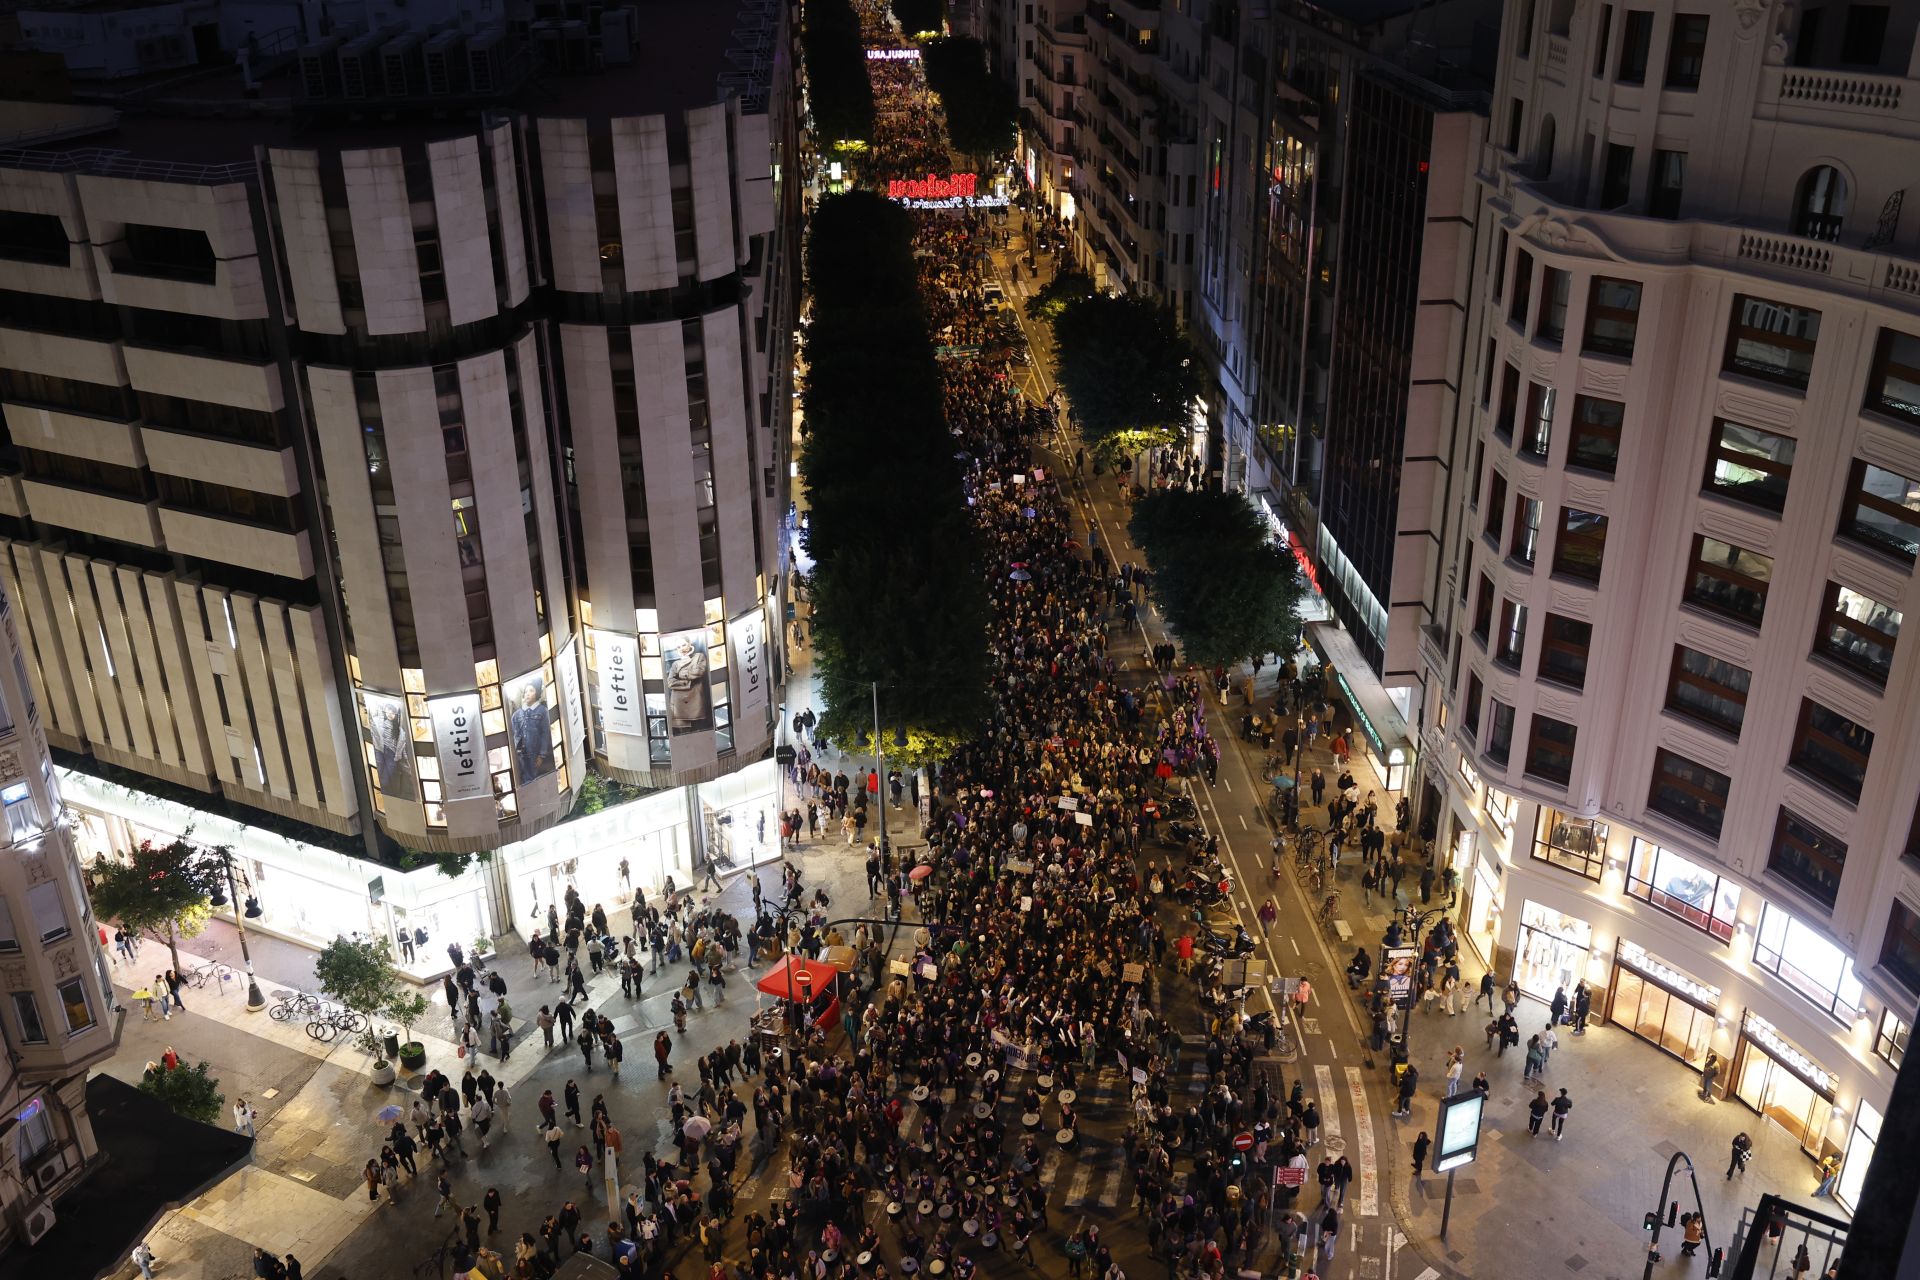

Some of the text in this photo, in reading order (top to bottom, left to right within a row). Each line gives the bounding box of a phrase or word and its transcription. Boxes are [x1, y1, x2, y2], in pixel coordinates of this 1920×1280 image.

[609, 645, 628, 711] lefties
[745, 623, 759, 693] lefties
[450, 706, 474, 776] lefties
[1623, 948, 1710, 1005] PULL&BEAR
[1747, 1018, 1830, 1090] PULL&BEAR
